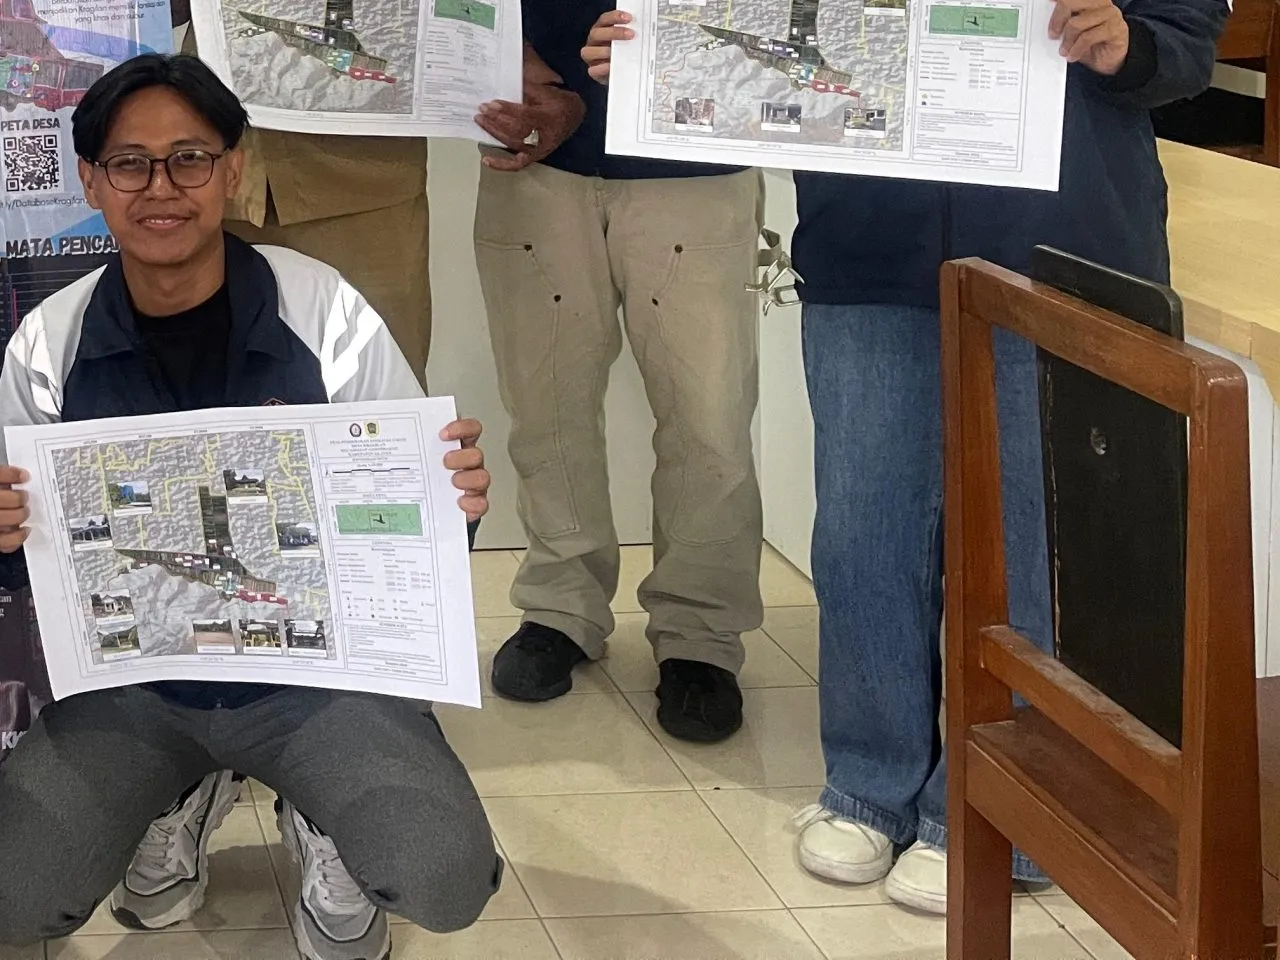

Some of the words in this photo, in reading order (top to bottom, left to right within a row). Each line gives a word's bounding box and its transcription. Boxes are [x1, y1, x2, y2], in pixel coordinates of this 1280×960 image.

[0, 119, 30, 132] PETA
[32, 118, 60, 130] DESA
[5, 238, 55, 258] MATA
